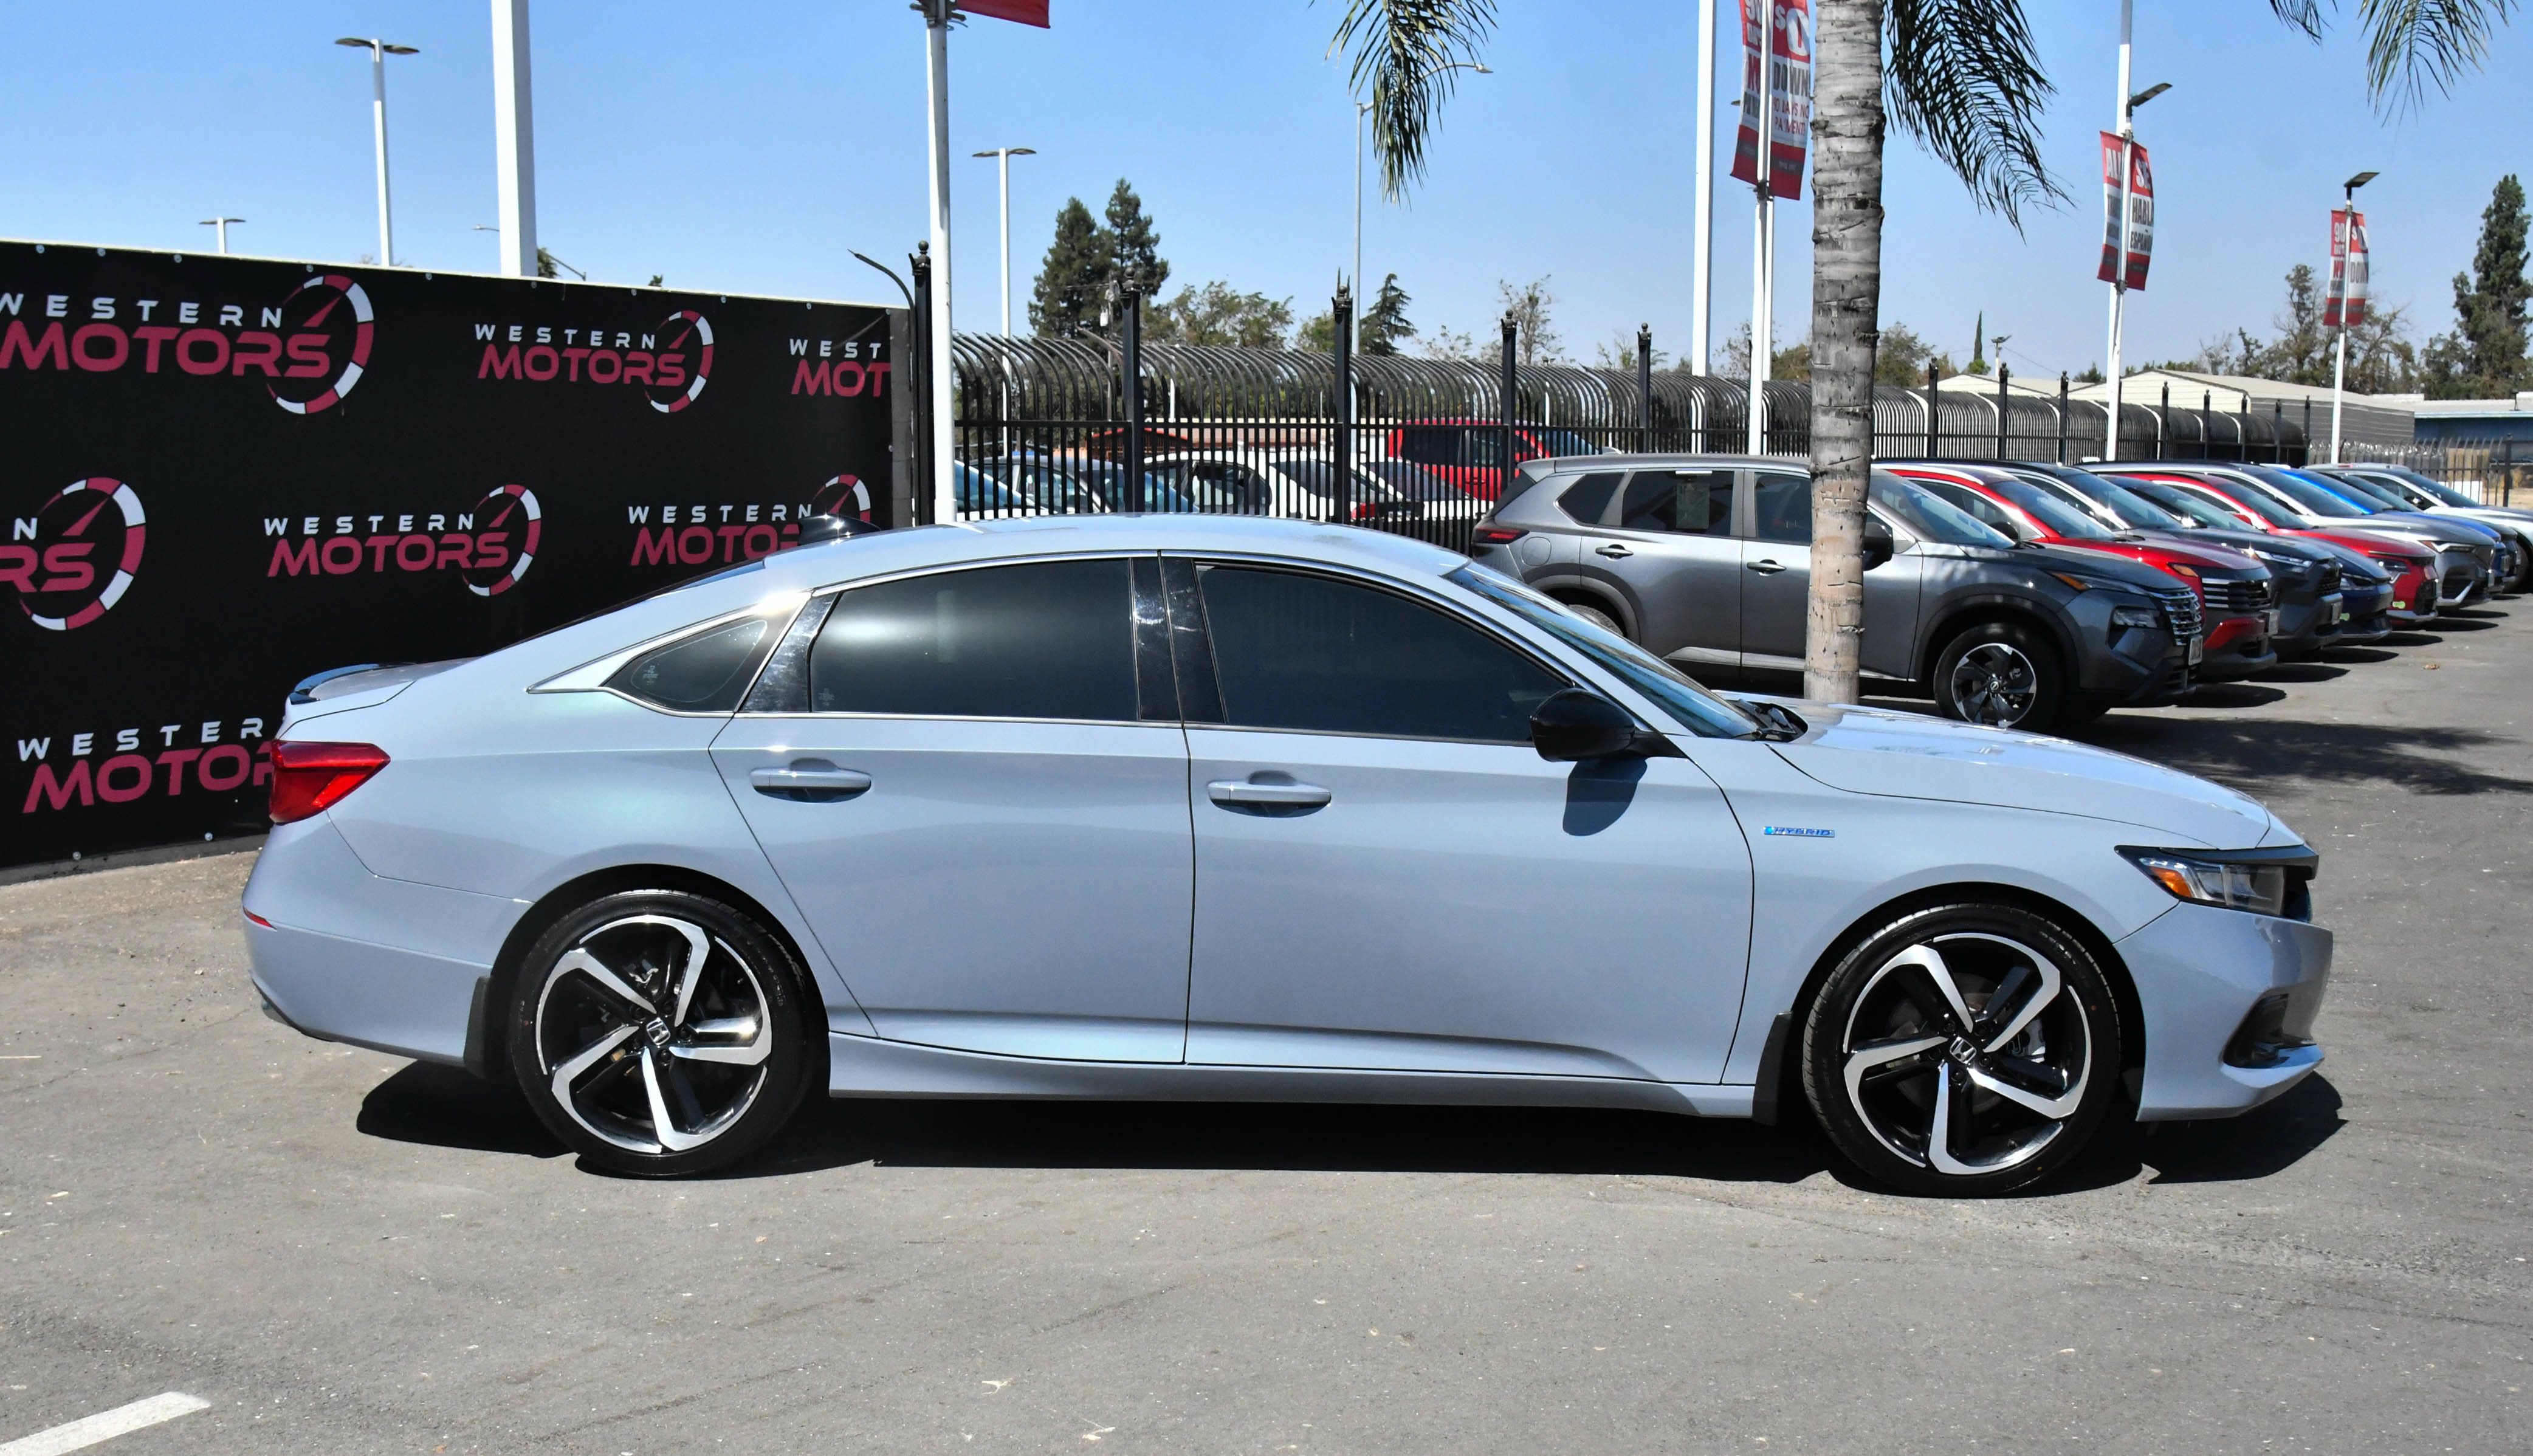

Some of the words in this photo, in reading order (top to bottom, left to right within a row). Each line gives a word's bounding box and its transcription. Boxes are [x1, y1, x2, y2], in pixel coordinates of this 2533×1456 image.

[1773, 61, 1809, 97] DOWN
[0, 292, 283, 328] WESTERN
[0, 320, 330, 378] MOTORS
[475, 324, 655, 349] WESTERN
[789, 338, 882, 359] WEST
[478, 344, 686, 386] MOTORS
[264, 513, 474, 536] WESTERN
[628, 504, 812, 524] WESTERN
[267, 532, 509, 577] MOTORS
[631, 524, 800, 566] MOTO
[18, 718, 263, 761] WESTER
[22, 740, 272, 813] MOTO
[1774, 827, 1830, 836] HYBRID
